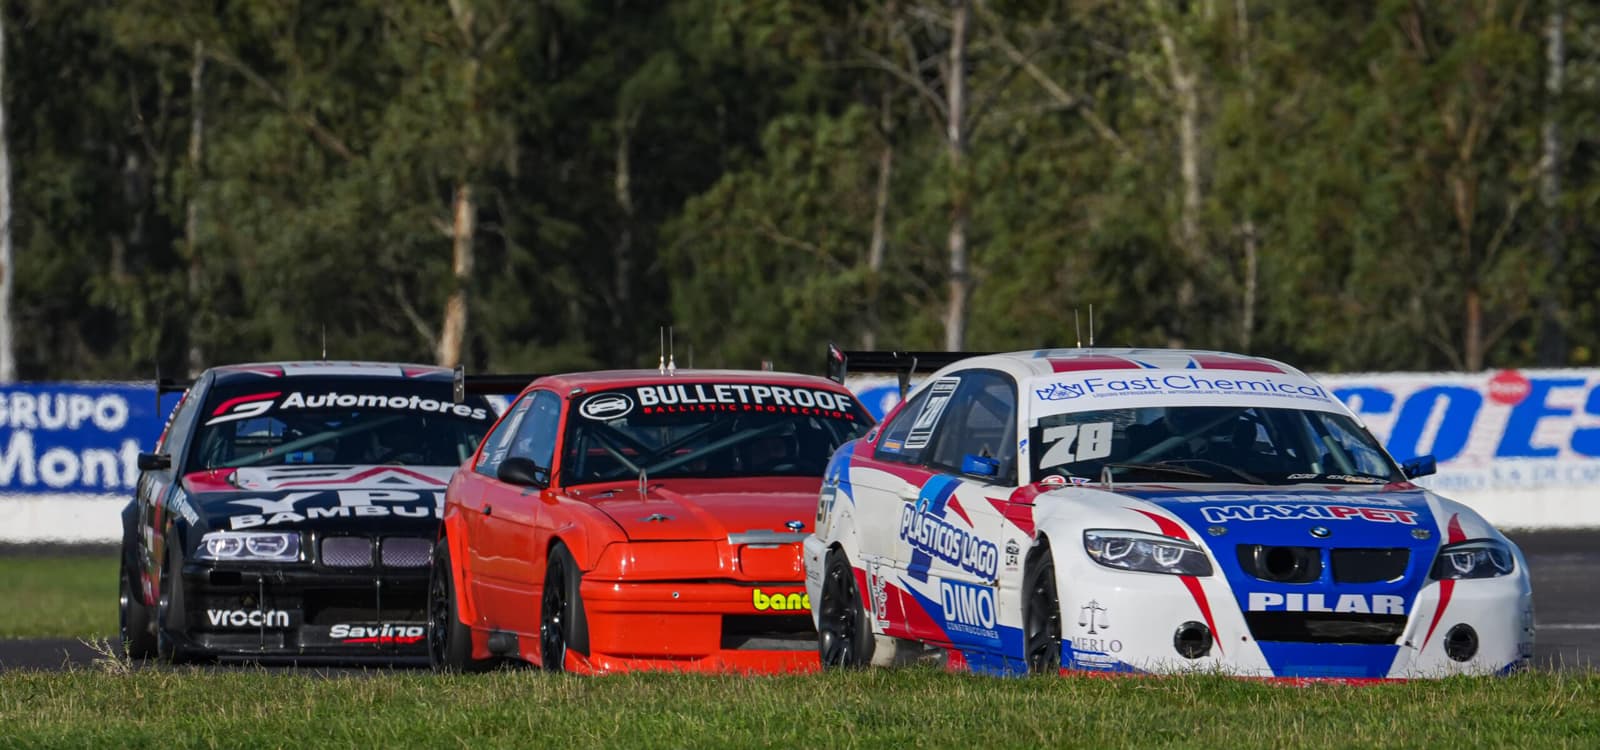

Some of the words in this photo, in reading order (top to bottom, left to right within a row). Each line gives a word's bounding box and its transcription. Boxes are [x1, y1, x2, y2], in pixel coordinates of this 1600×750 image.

[636, 384, 853, 413] BULLETPROOF
[1083, 375, 1328, 399] FastChemical
[0, 392, 128, 431] RUPO
[280, 391, 488, 420] Automotores
[643, 404, 738, 414] BALLISTIC
[745, 405, 857, 421] PROTECTION
[1039, 422, 1114, 470] 28
[227, 490, 452, 514] YP
[1200, 504, 1418, 526] MAXIPET
[900, 498, 962, 563] PLÁSTICOS
[961, 532, 998, 577] LAGO
[941, 582, 995, 630] DIMO
[1248, 592, 1405, 615] PILAR
[207, 609, 290, 627] vroom
[329, 624, 424, 638] Savino
[1071, 636, 1124, 653] MERLO
